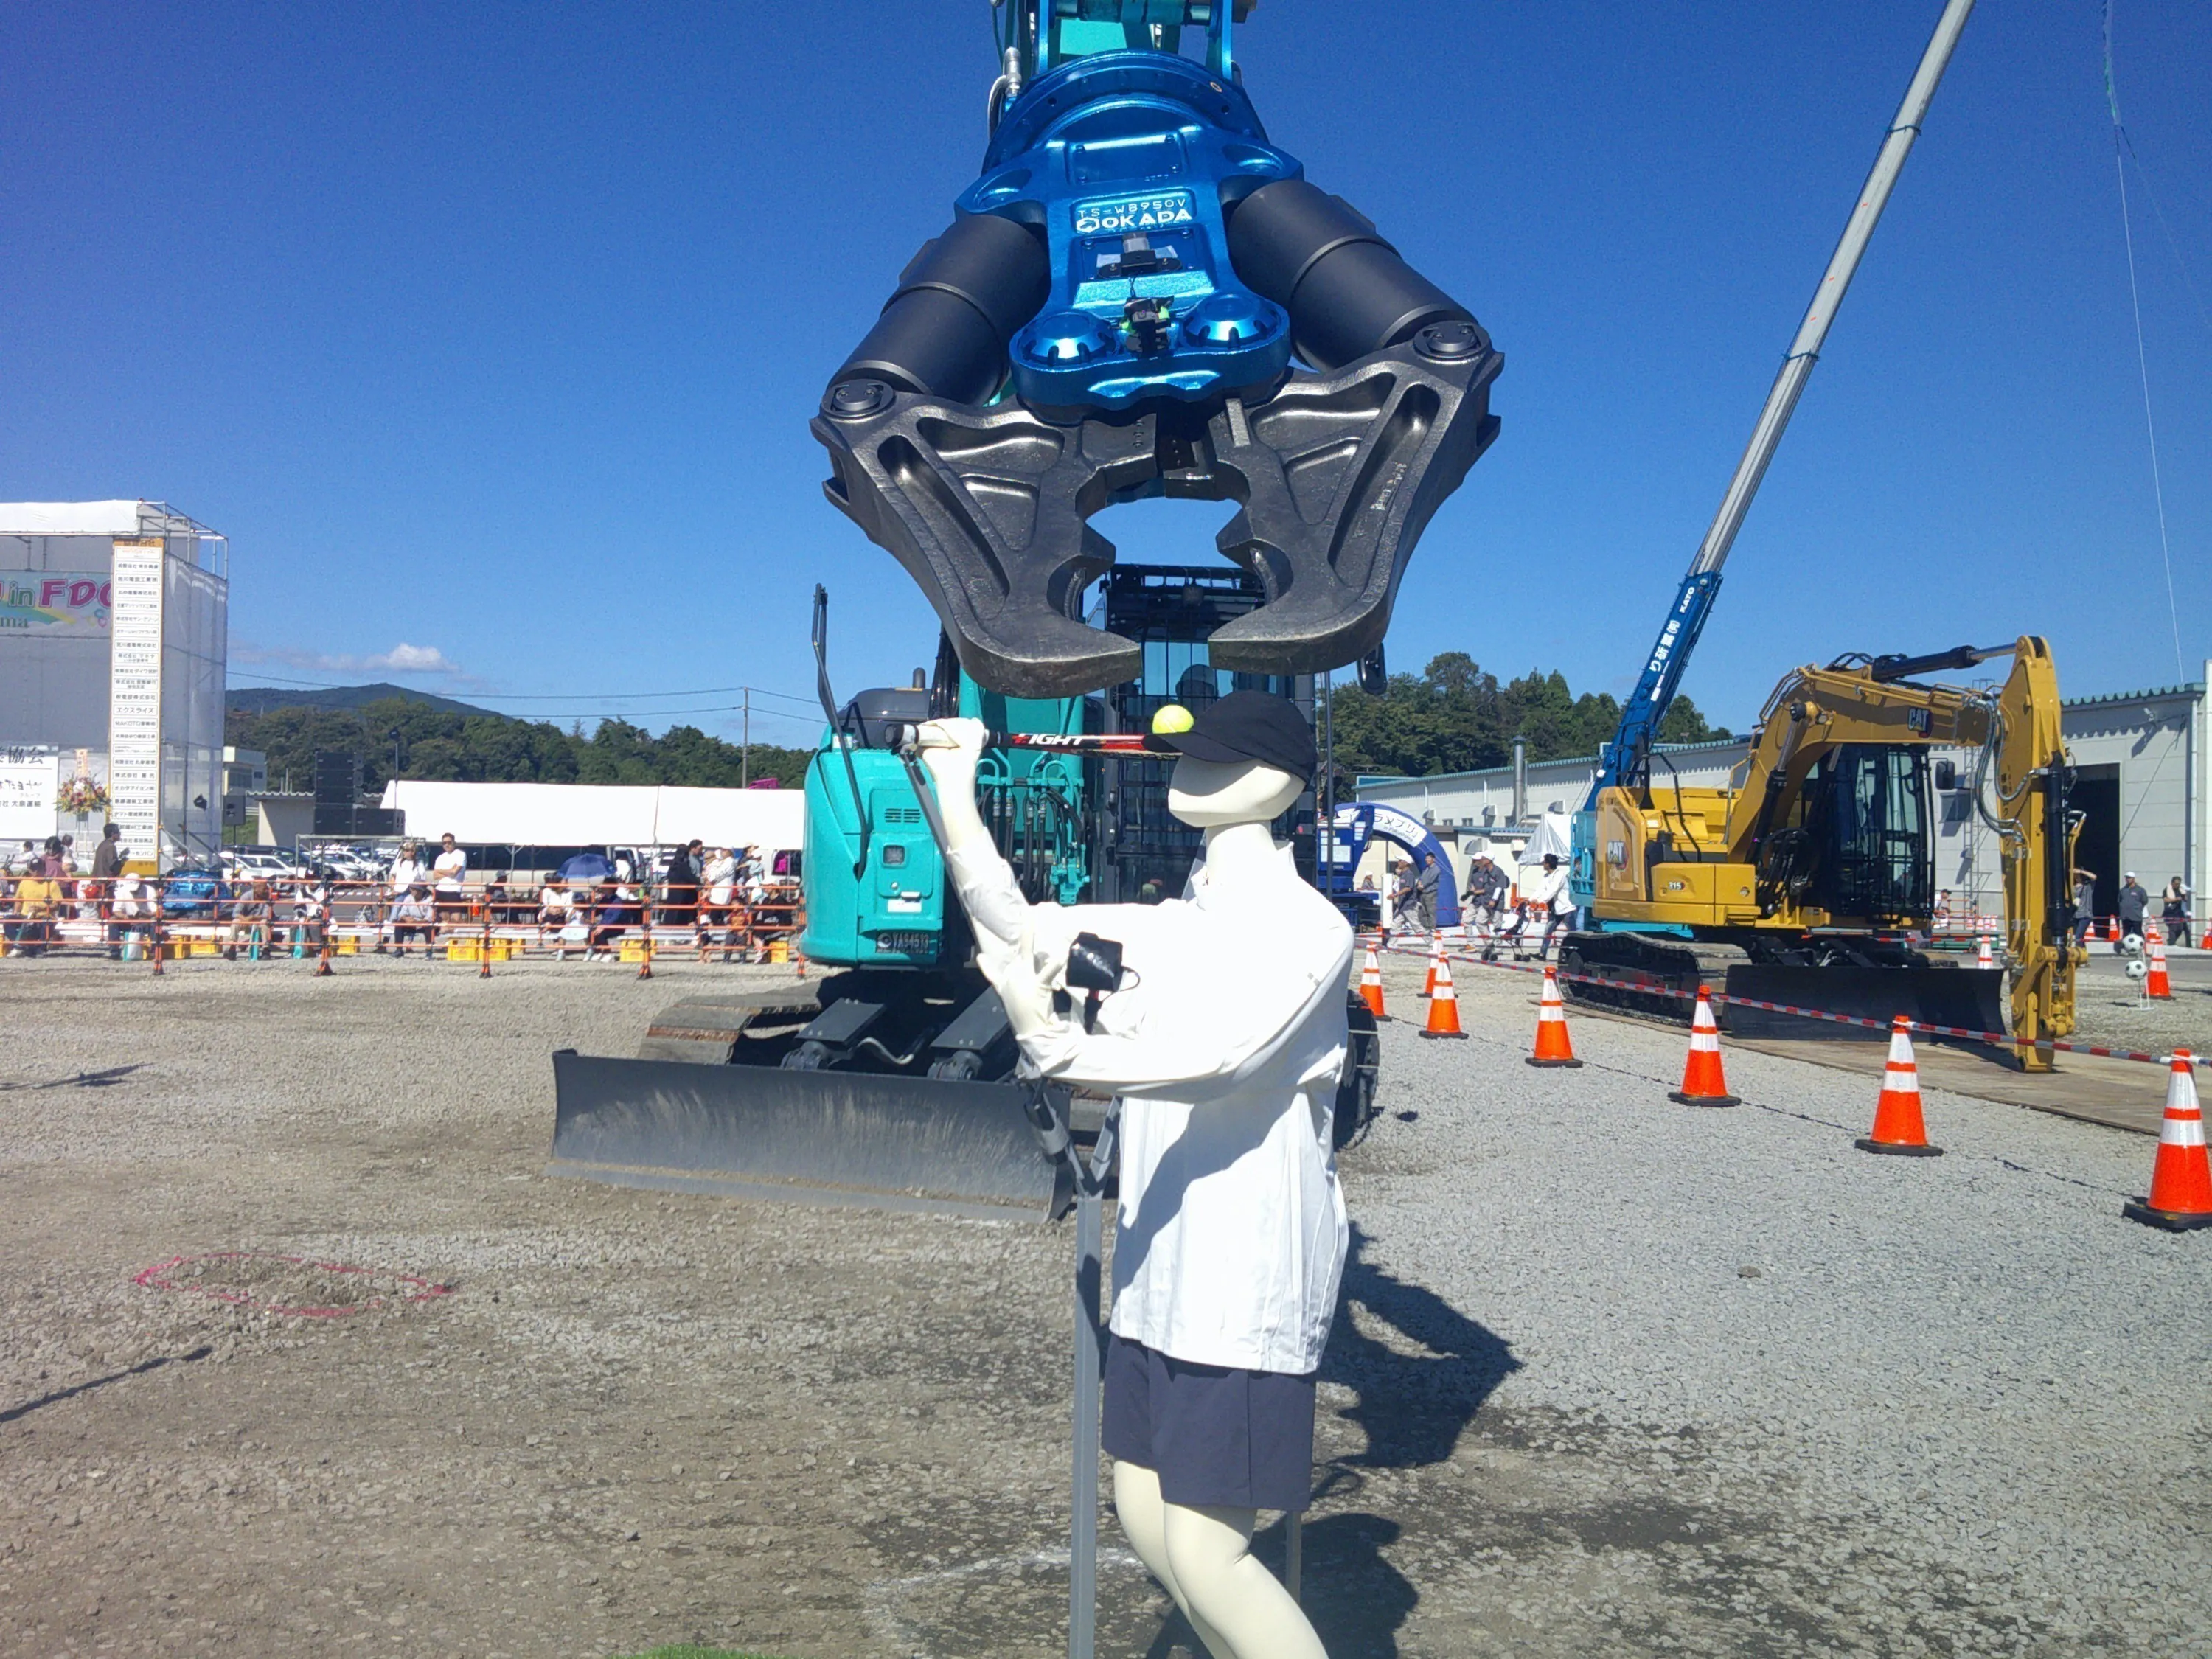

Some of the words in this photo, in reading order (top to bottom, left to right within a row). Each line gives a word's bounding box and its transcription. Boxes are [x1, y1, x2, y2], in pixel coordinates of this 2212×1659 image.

[1078, 198, 1186, 218] TS-WB950V
[1102, 209, 1192, 229] OKADA
[8, 581, 35, 607] in
[1679, 587, 1695, 613] KATO
[1908, 708, 1929, 731] CAT
[1607, 841, 1624, 864] CAT
[1669, 882, 1681, 891] 315
